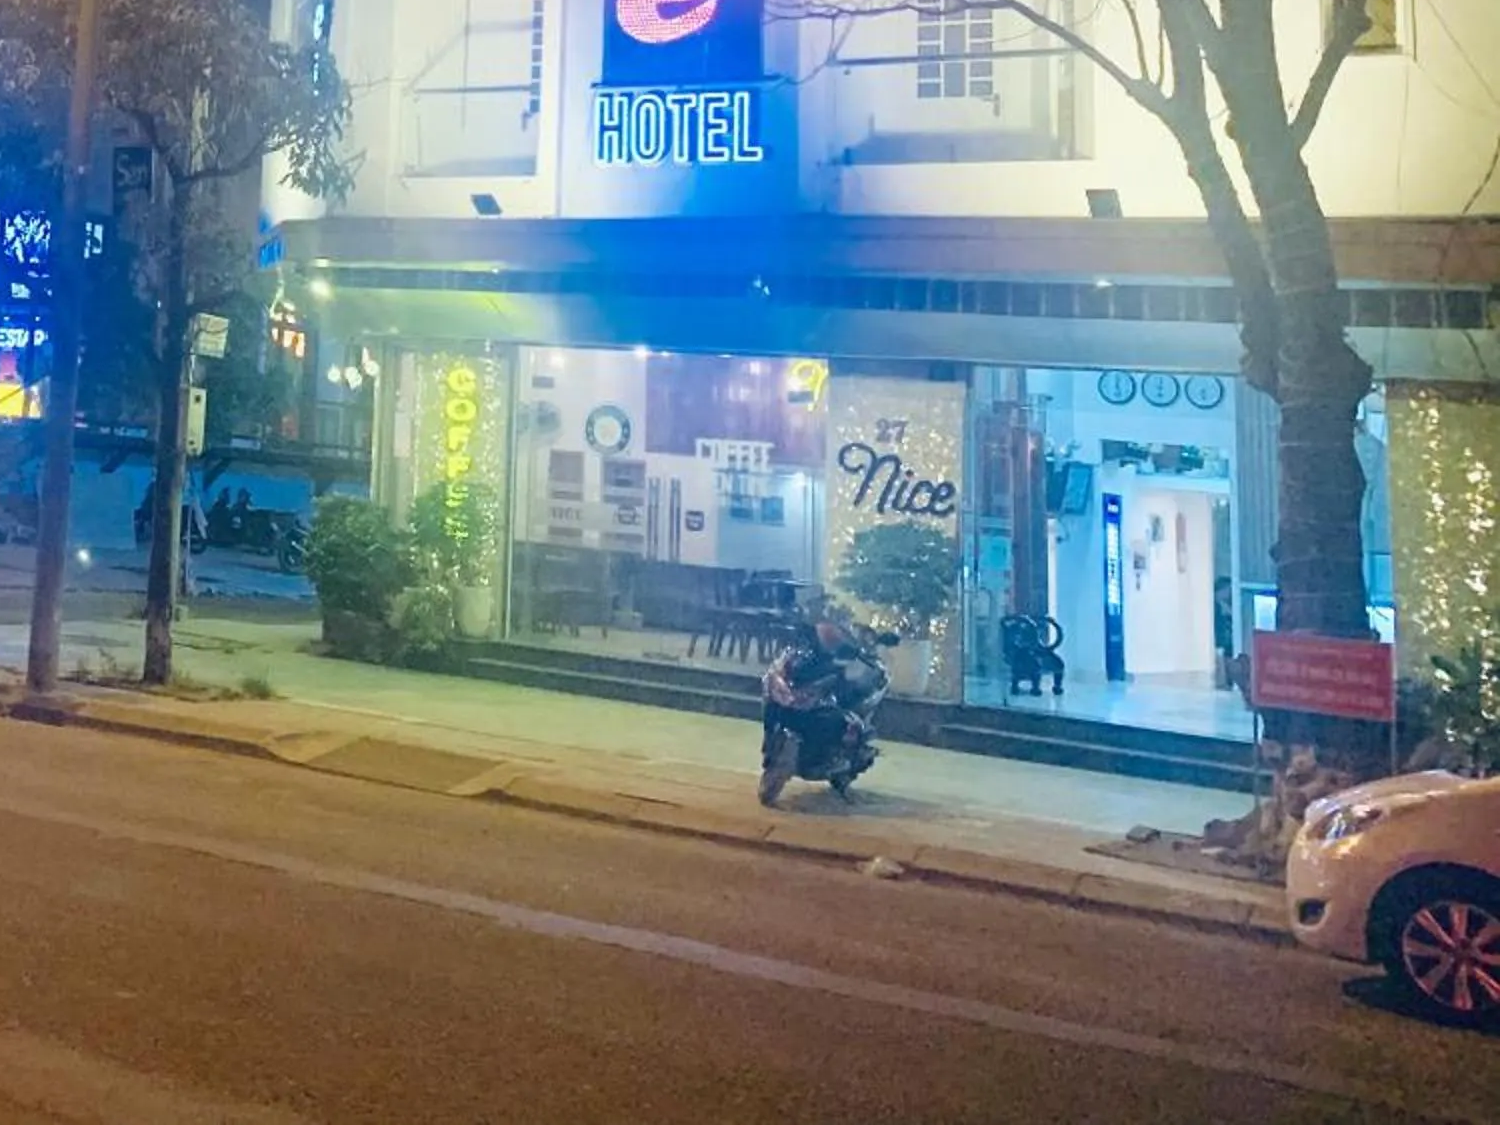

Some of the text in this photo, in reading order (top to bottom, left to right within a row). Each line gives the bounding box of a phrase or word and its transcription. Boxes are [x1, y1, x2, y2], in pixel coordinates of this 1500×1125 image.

[593, 90, 764, 166] HOTEL
[445, 367, 478, 542] COFFE
[875, 418, 908, 442] 27
[838, 442, 956, 516] Nice
